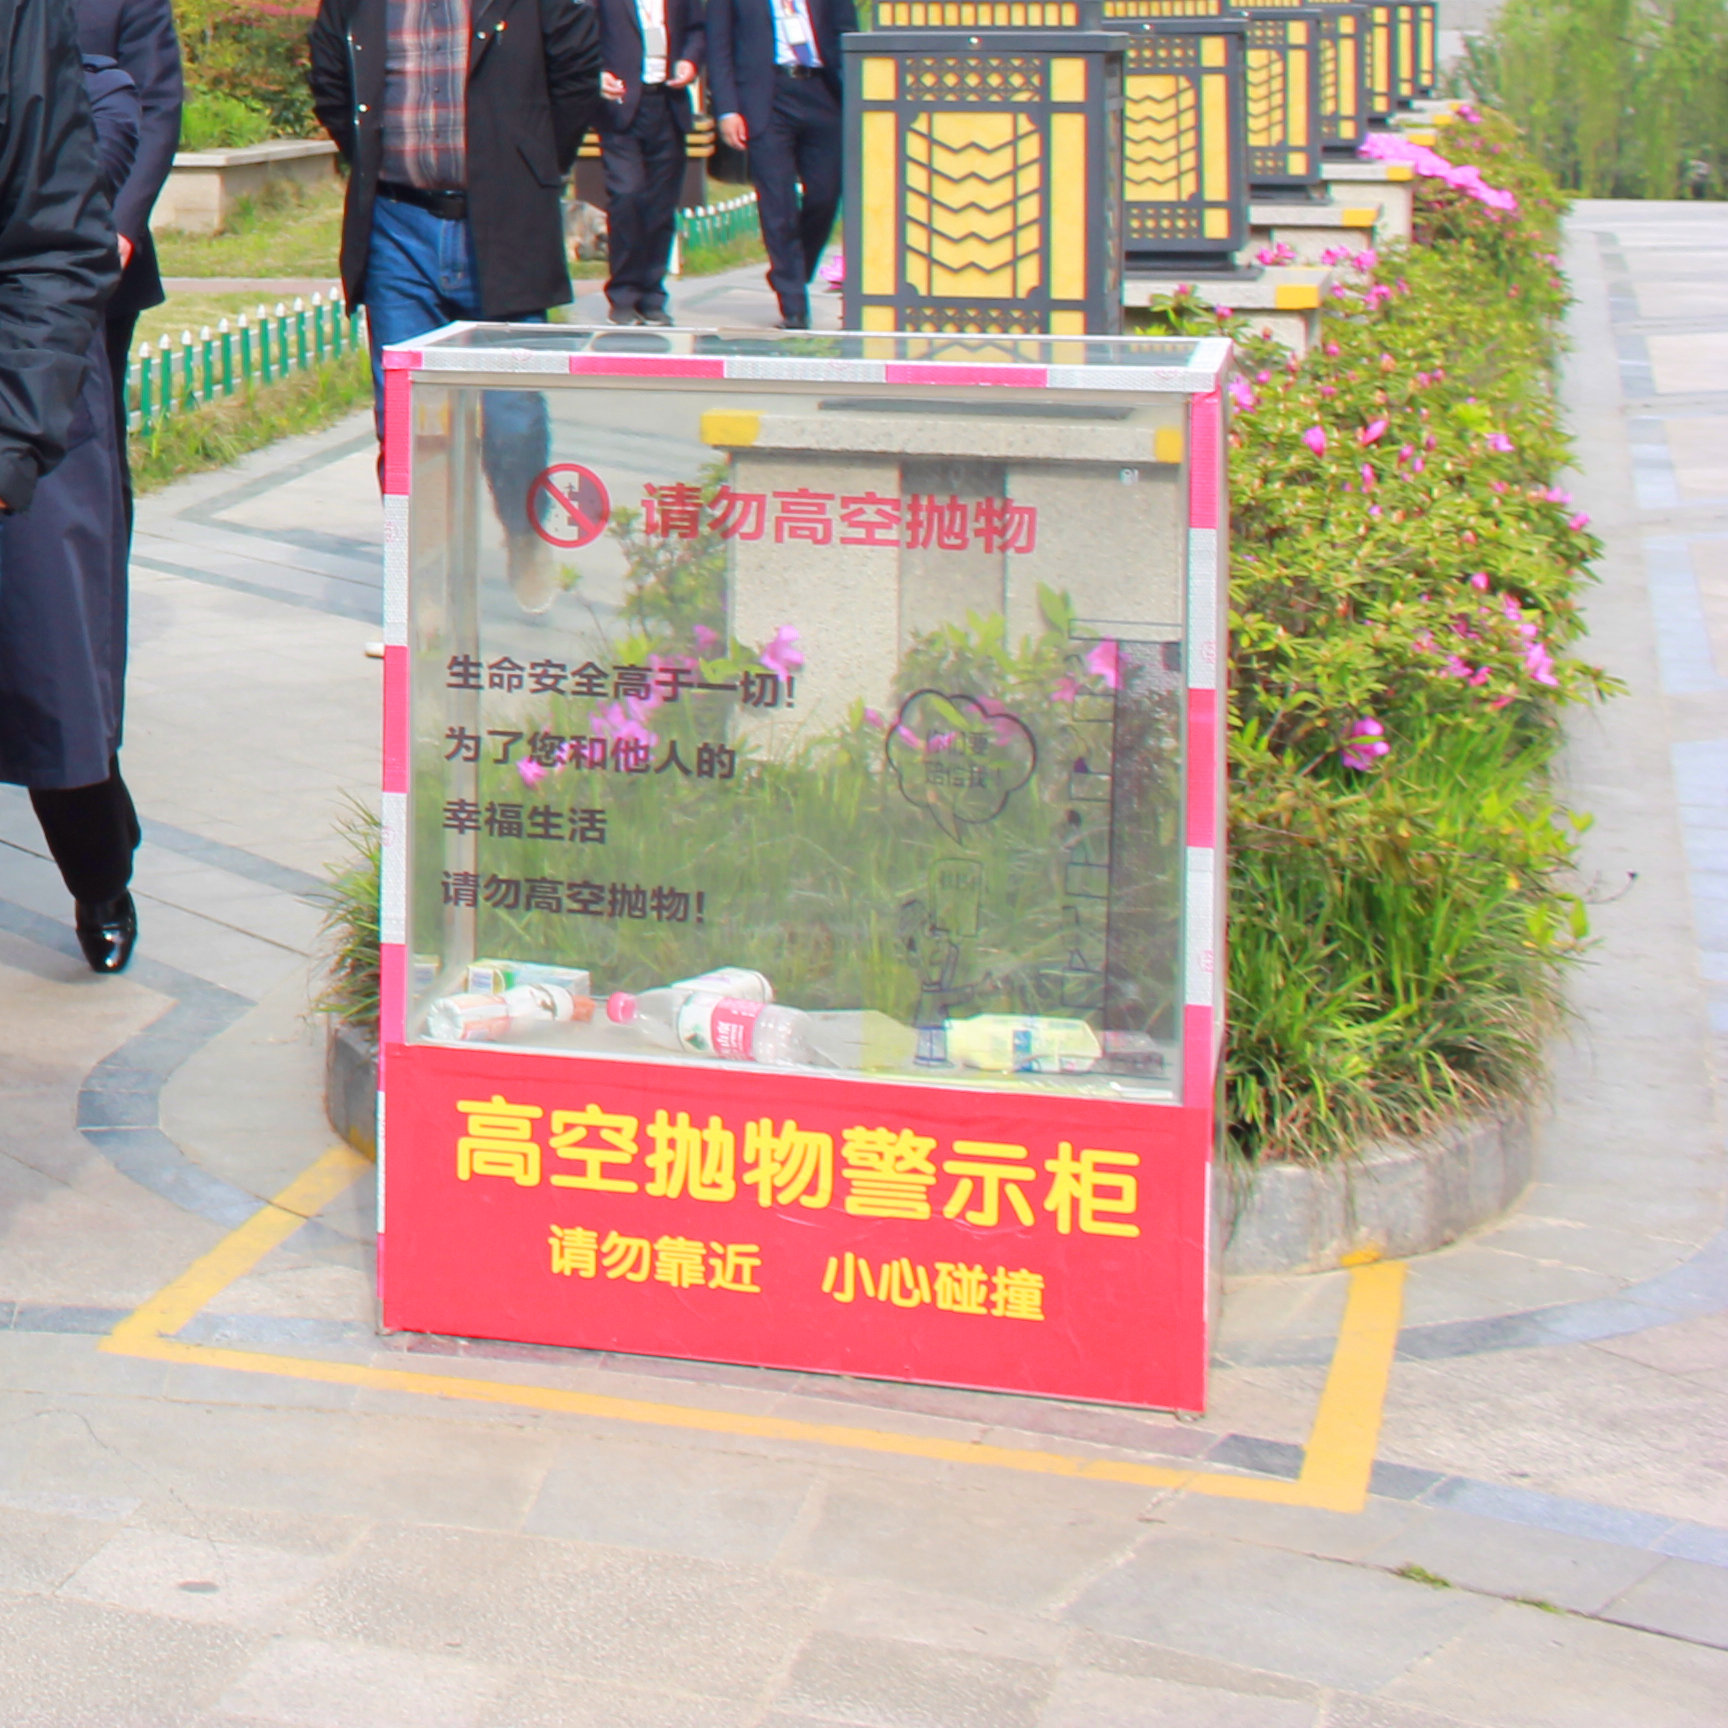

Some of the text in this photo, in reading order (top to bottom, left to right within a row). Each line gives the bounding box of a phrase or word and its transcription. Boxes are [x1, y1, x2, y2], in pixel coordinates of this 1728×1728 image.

[641, 482, 1037, 554] 请勿高空抛物
[446, 654, 796, 708] 生命安全高于一切!
[444, 726, 737, 780] 为了您和他人的
[442, 798, 608, 844] 幸福生活
[441, 870, 706, 923] 请勿高空抛物!
[455, 1094, 1141, 1239] 高空抛物警示柜
[548, 1225, 1045, 1321] 请勿靠近 小心碰撞
